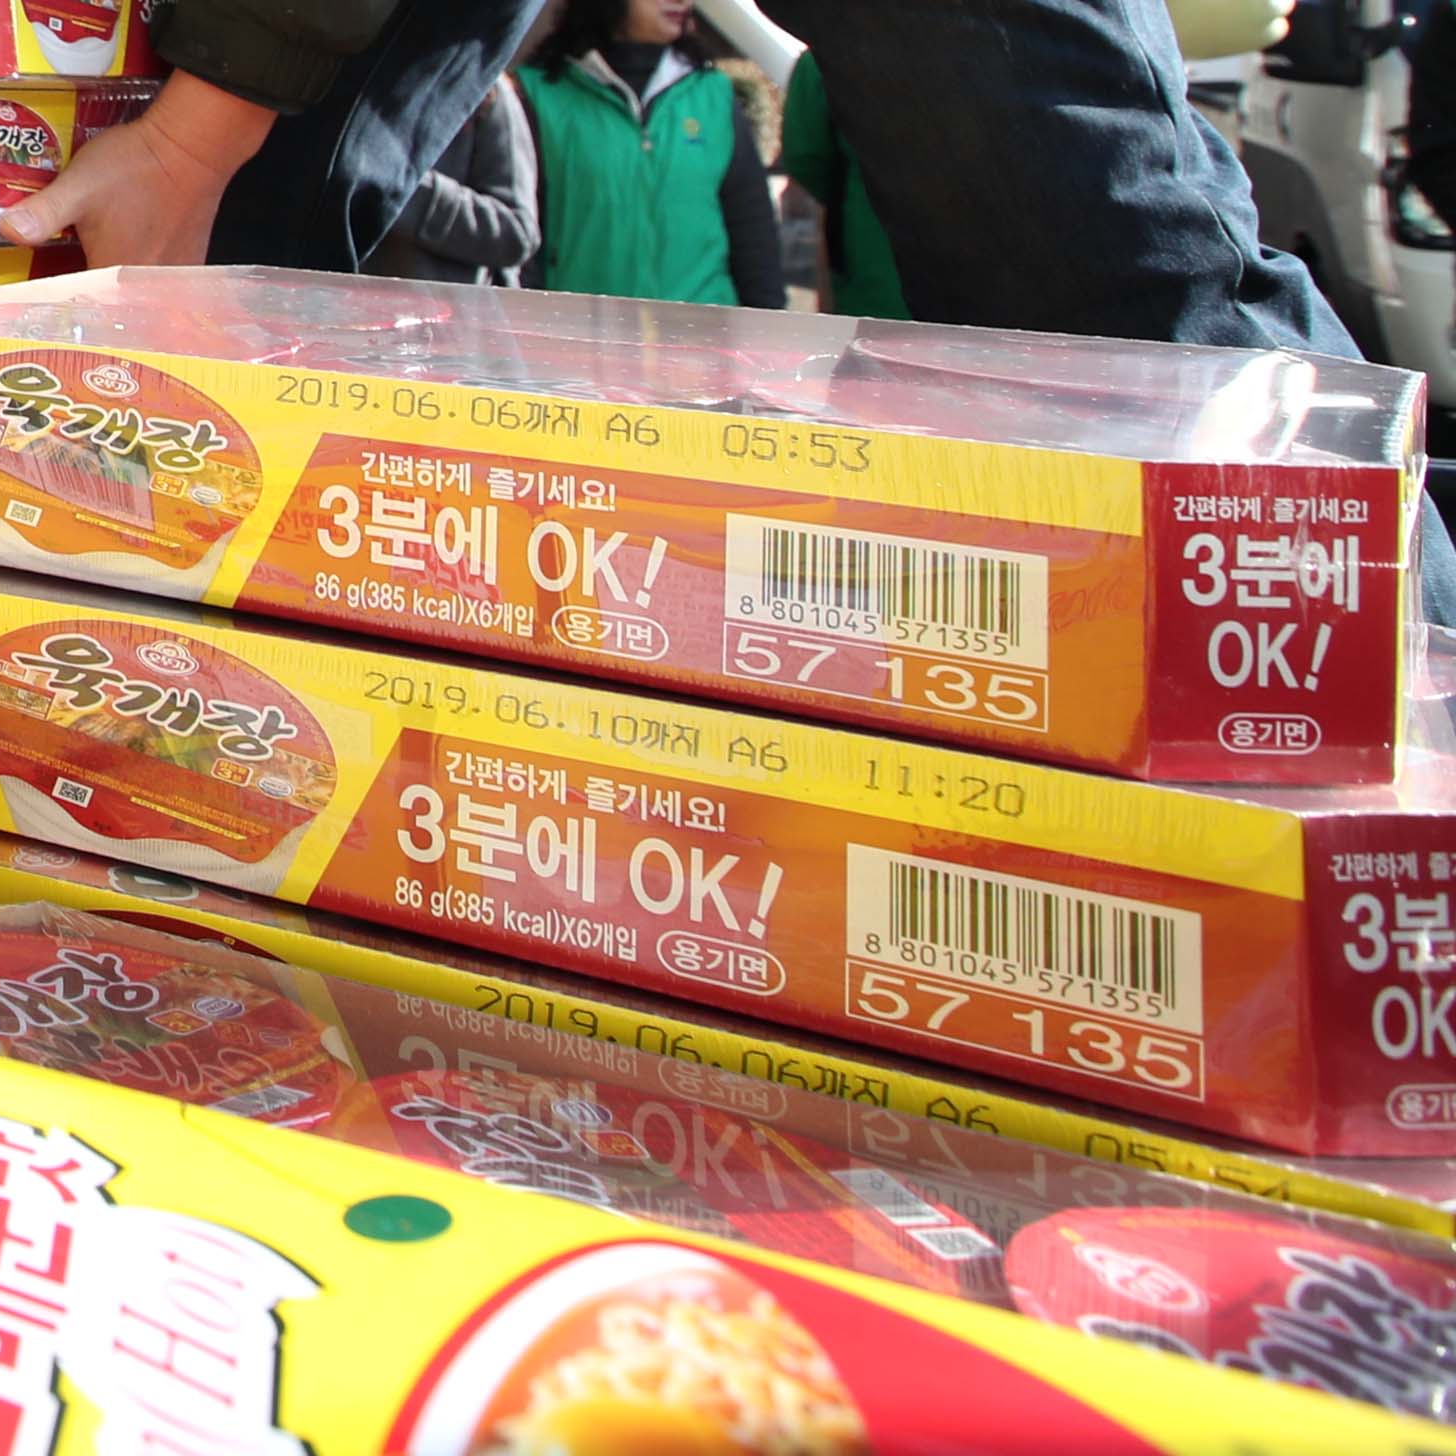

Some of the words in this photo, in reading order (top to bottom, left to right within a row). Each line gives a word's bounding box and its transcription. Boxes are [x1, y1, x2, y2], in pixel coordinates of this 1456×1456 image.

[605, 412, 660, 446] A6
[722, 423, 872, 473] 05:53
[361, 452, 471, 496] 간편하게
[487, 467, 617, 513] 즐기세요!
[1173, 496, 1262, 524] 간편하게
[1272, 496, 1369, 525] 즐기세요!
[316, 484, 498, 585] 3분에
[527, 520, 668, 608] OK!
[1181, 532, 1360, 614] 3분에
[315, 571, 341, 600] 86
[565, 613, 653, 654] 용기면
[772, 598, 877, 635] 801045
[895, 619, 1008, 657] 571355
[1207, 621, 1332, 694] OK!
[11, 633, 298, 760] 육개장
[733, 633, 836, 684] 57
[884, 660, 1039, 722] 135
[1230, 720, 1309, 749] 용기면
[445, 751, 568, 804] 간편하게
[584, 775, 727, 833] 즐기세요!
[727, 736, 788, 773] A6
[863, 758, 1026, 819] 11:20
[395, 876, 423, 908] 86
[397, 783, 597, 904] 3분에
[629, 837, 784, 941] OK!
[1330, 854, 1418, 881] 간편하게
[670, 939, 768, 988] 용기면
[898, 936, 1020, 984] 801045
[1037, 967, 1164, 1019] 571355
[857, 973, 971, 1022] 57
[1011, 1009, 1194, 1088] 135
